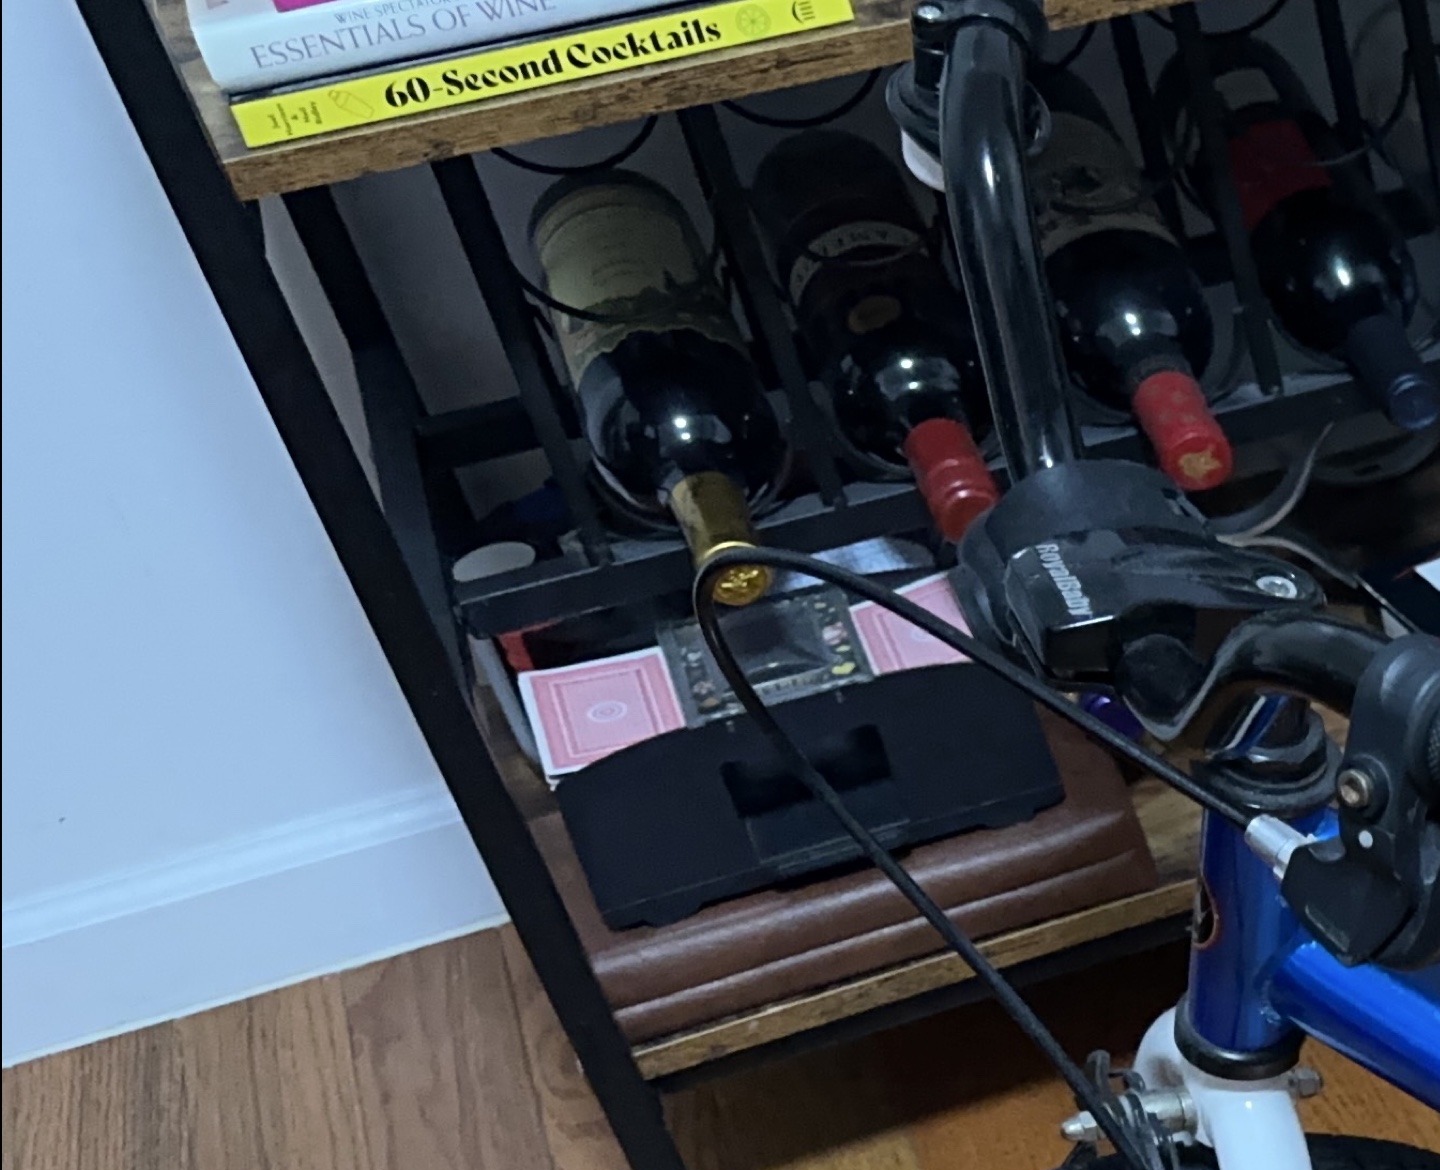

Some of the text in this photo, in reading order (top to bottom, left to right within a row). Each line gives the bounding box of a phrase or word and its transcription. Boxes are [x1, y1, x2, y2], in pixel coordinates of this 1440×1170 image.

[250, 19, 427, 69] ESSENTIALS
[432, 5, 475, 32] OF
[374, 0, 451, 17] SPECTATO
[385, 18, 722, 108] 60-Second Cocktails
